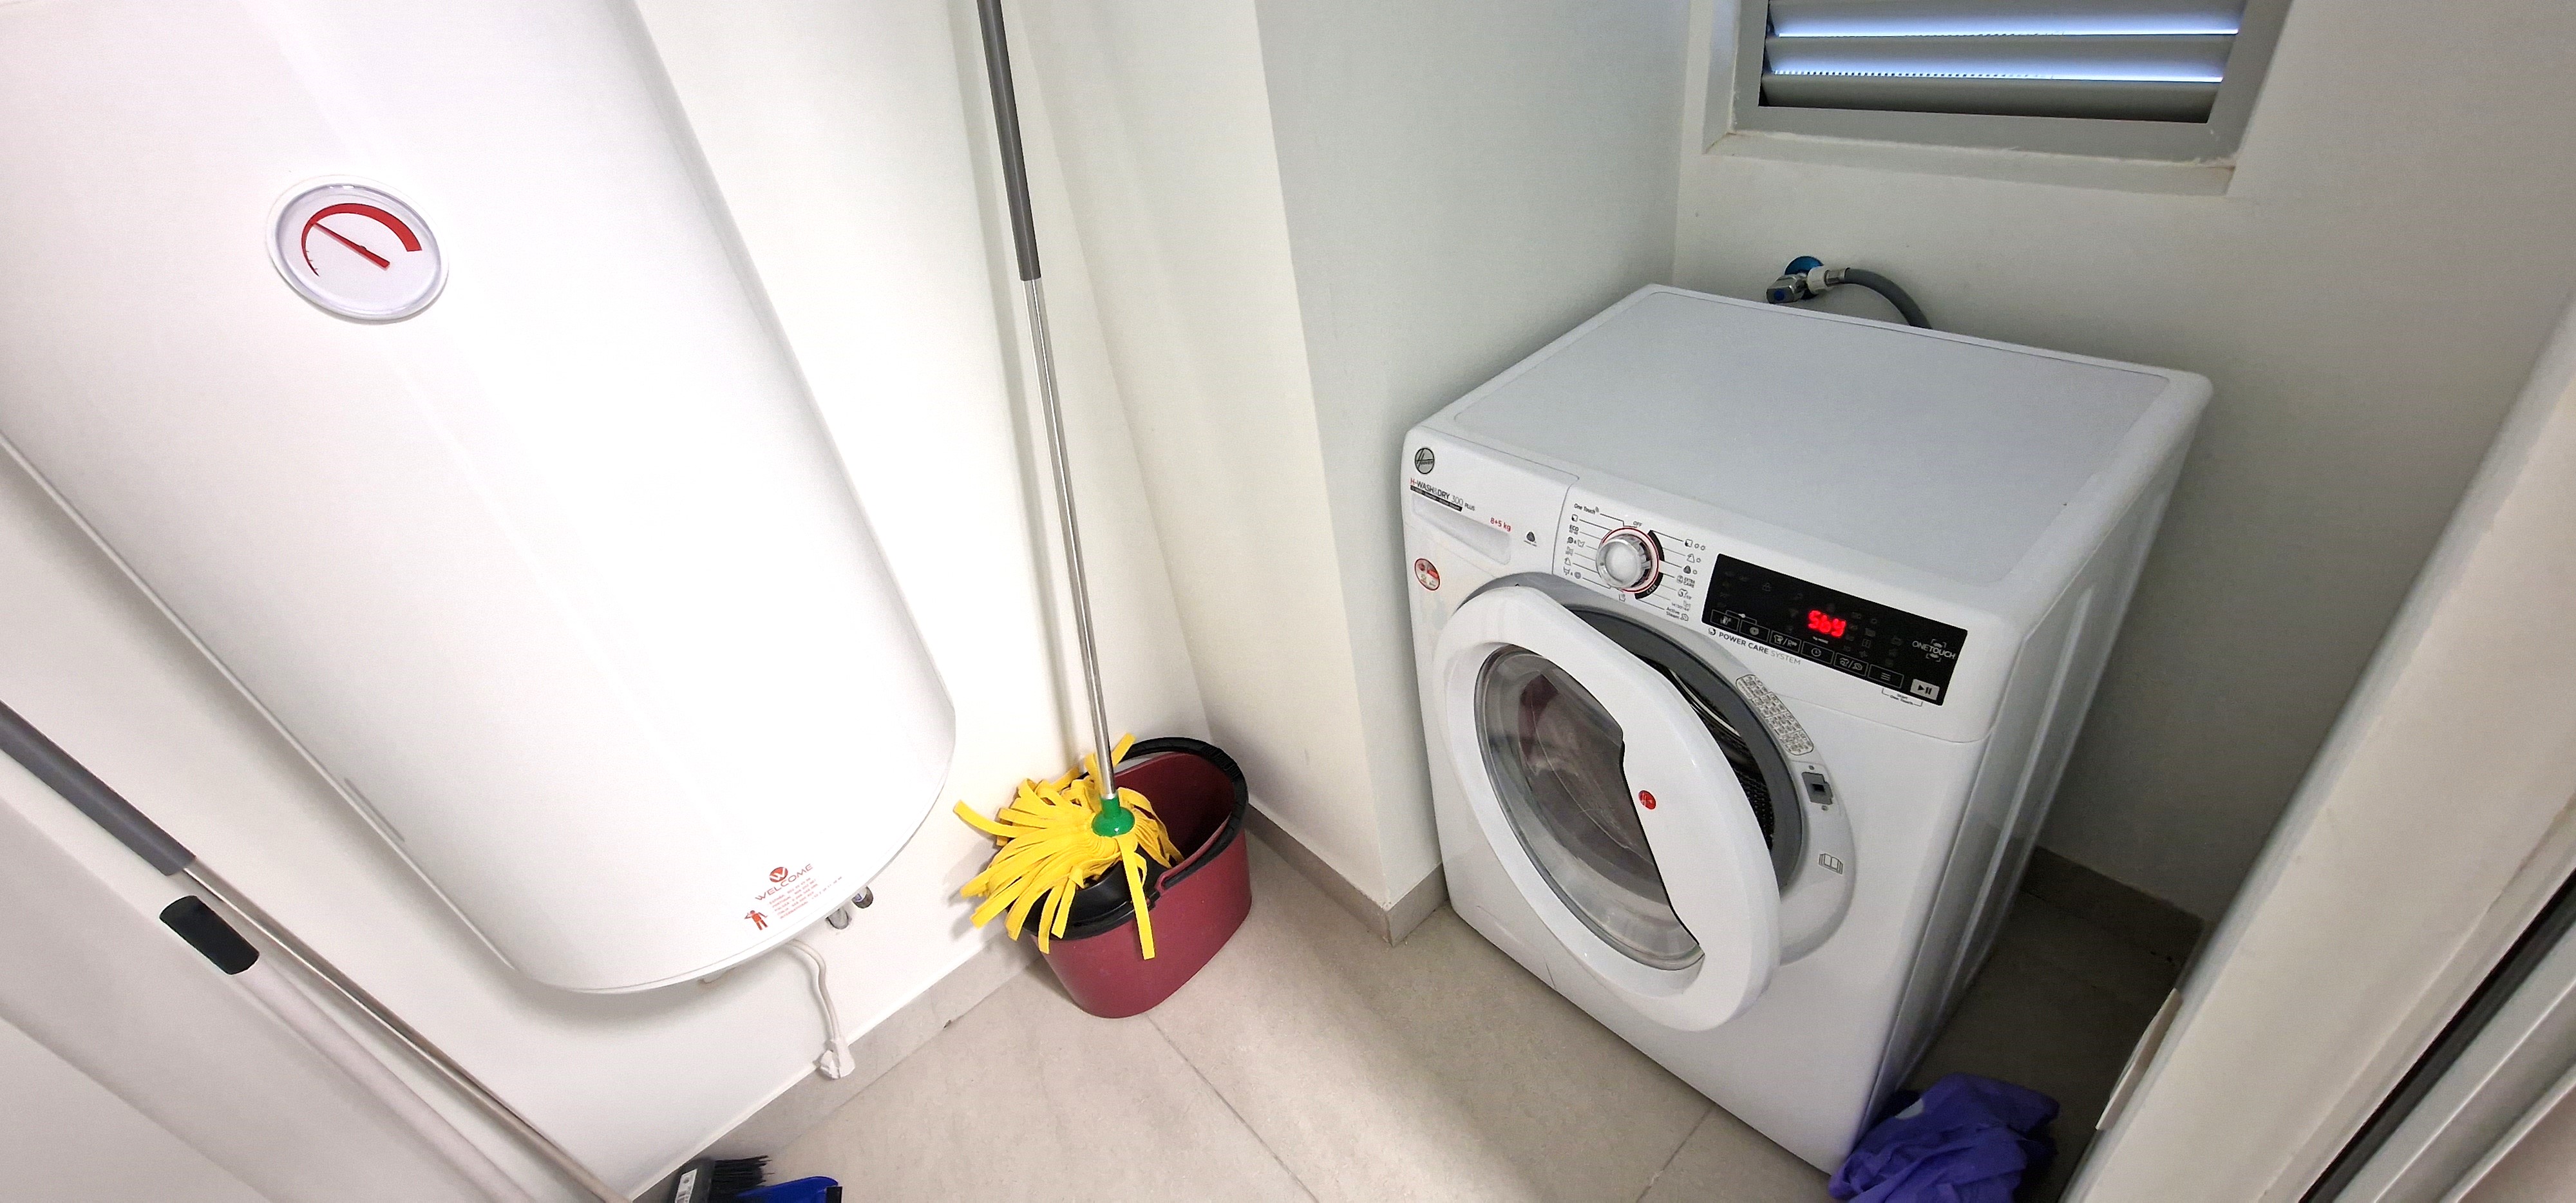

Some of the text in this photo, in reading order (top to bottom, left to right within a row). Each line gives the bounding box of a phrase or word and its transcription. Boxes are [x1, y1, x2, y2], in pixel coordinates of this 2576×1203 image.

[1452, 495, 1464, 506] 300
[1464, 503, 1475, 511] PLUS
[1490, 517, 1511, 532] 8+5 kg
[1719, 632, 1801, 665] POWER CARE SYSTEM
[755, 864, 813, 900] WELCOME
